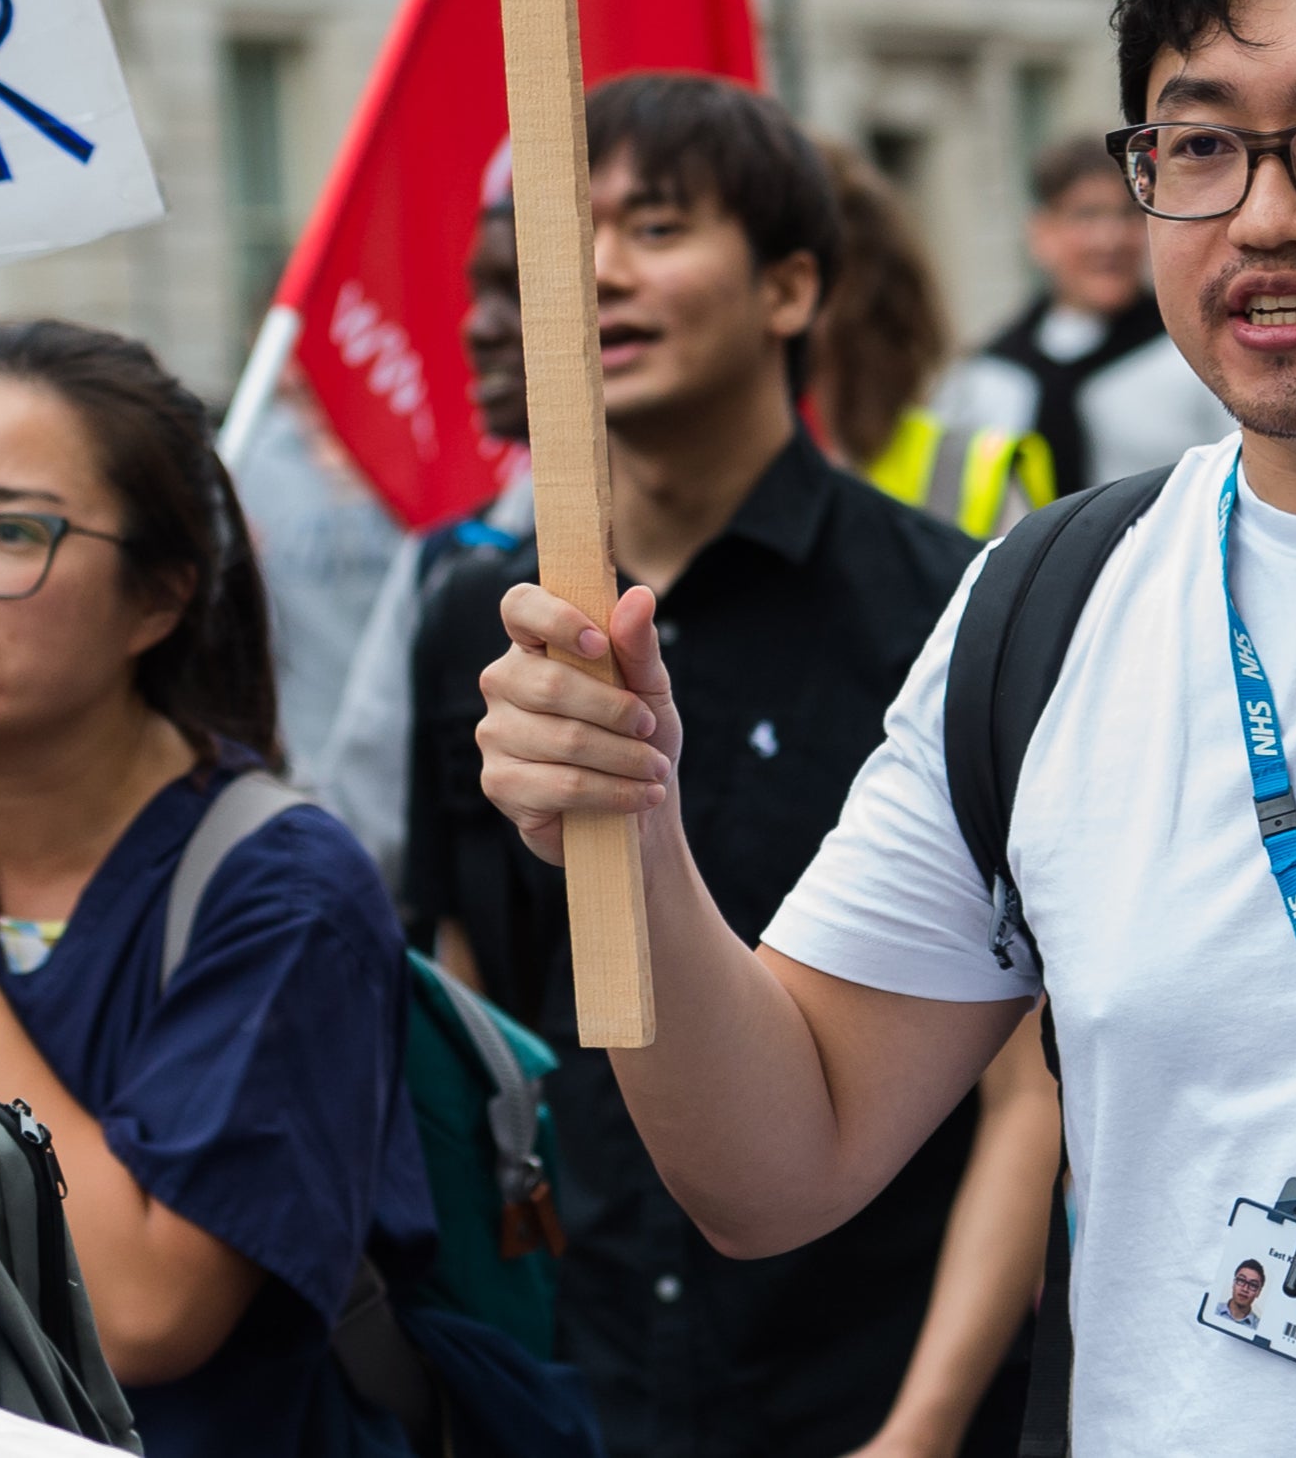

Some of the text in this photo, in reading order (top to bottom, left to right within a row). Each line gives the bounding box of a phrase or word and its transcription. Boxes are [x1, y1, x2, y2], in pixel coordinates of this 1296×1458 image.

[1233, 628, 1264, 680] NHS
[1246, 700, 1278, 756] NHS
[1268, 1247, 1285, 1261] East
